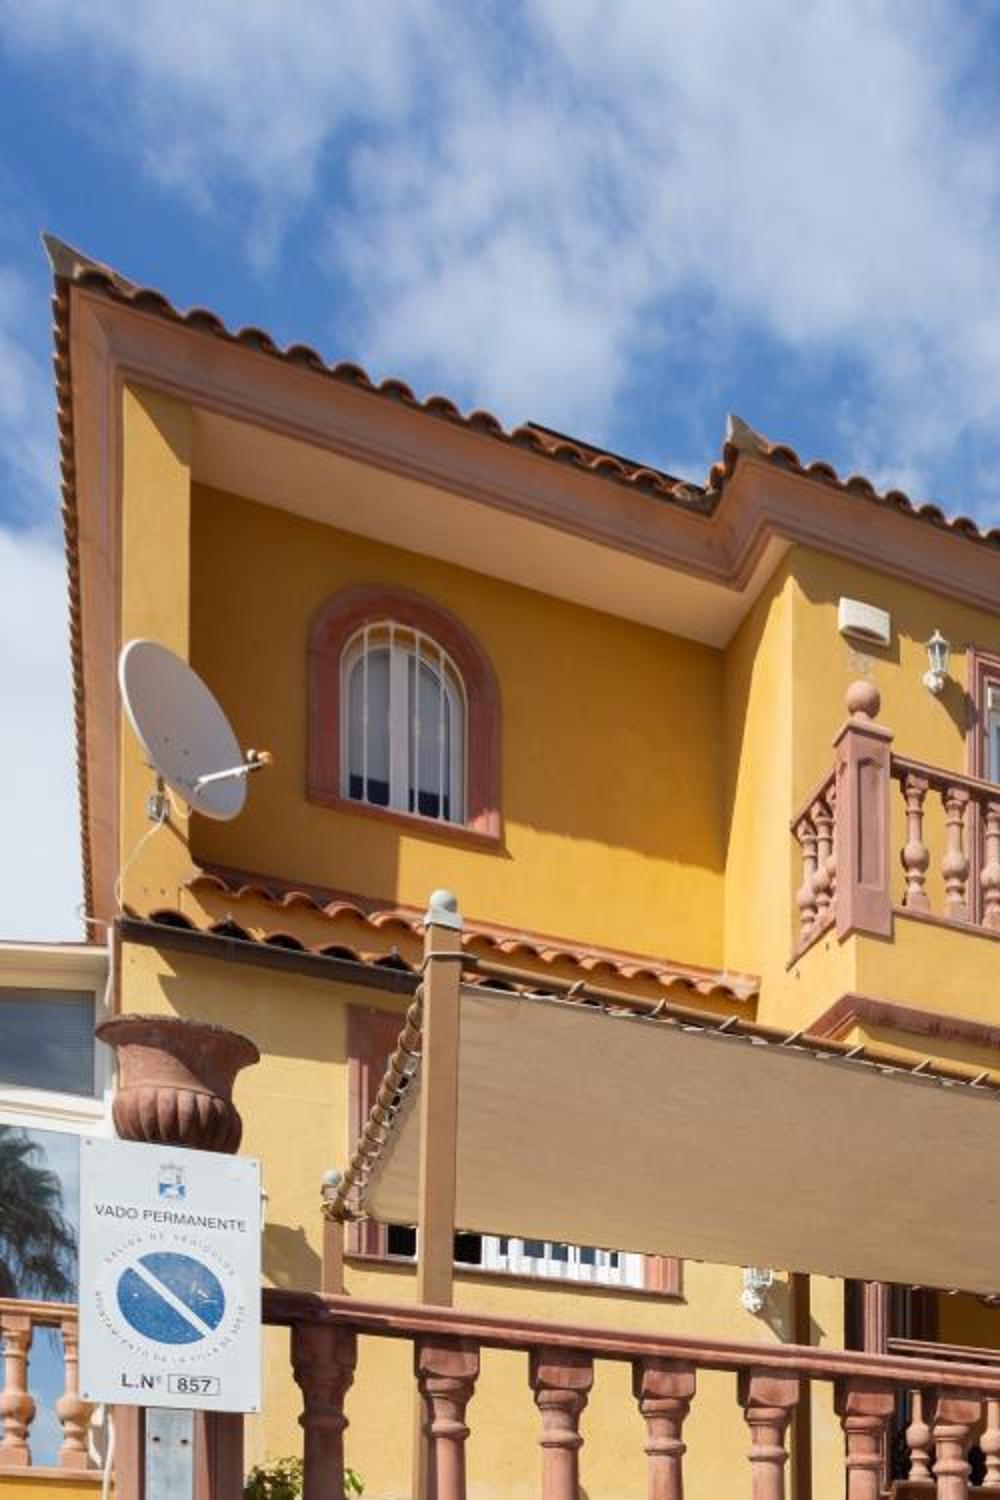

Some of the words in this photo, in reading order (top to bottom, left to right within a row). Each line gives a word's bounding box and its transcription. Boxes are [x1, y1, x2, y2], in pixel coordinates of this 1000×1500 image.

[95, 1204, 139, 1219] VADO
[142, 1209, 247, 1232] PERMANENTE
[177, 1377, 212, 1393] 857
